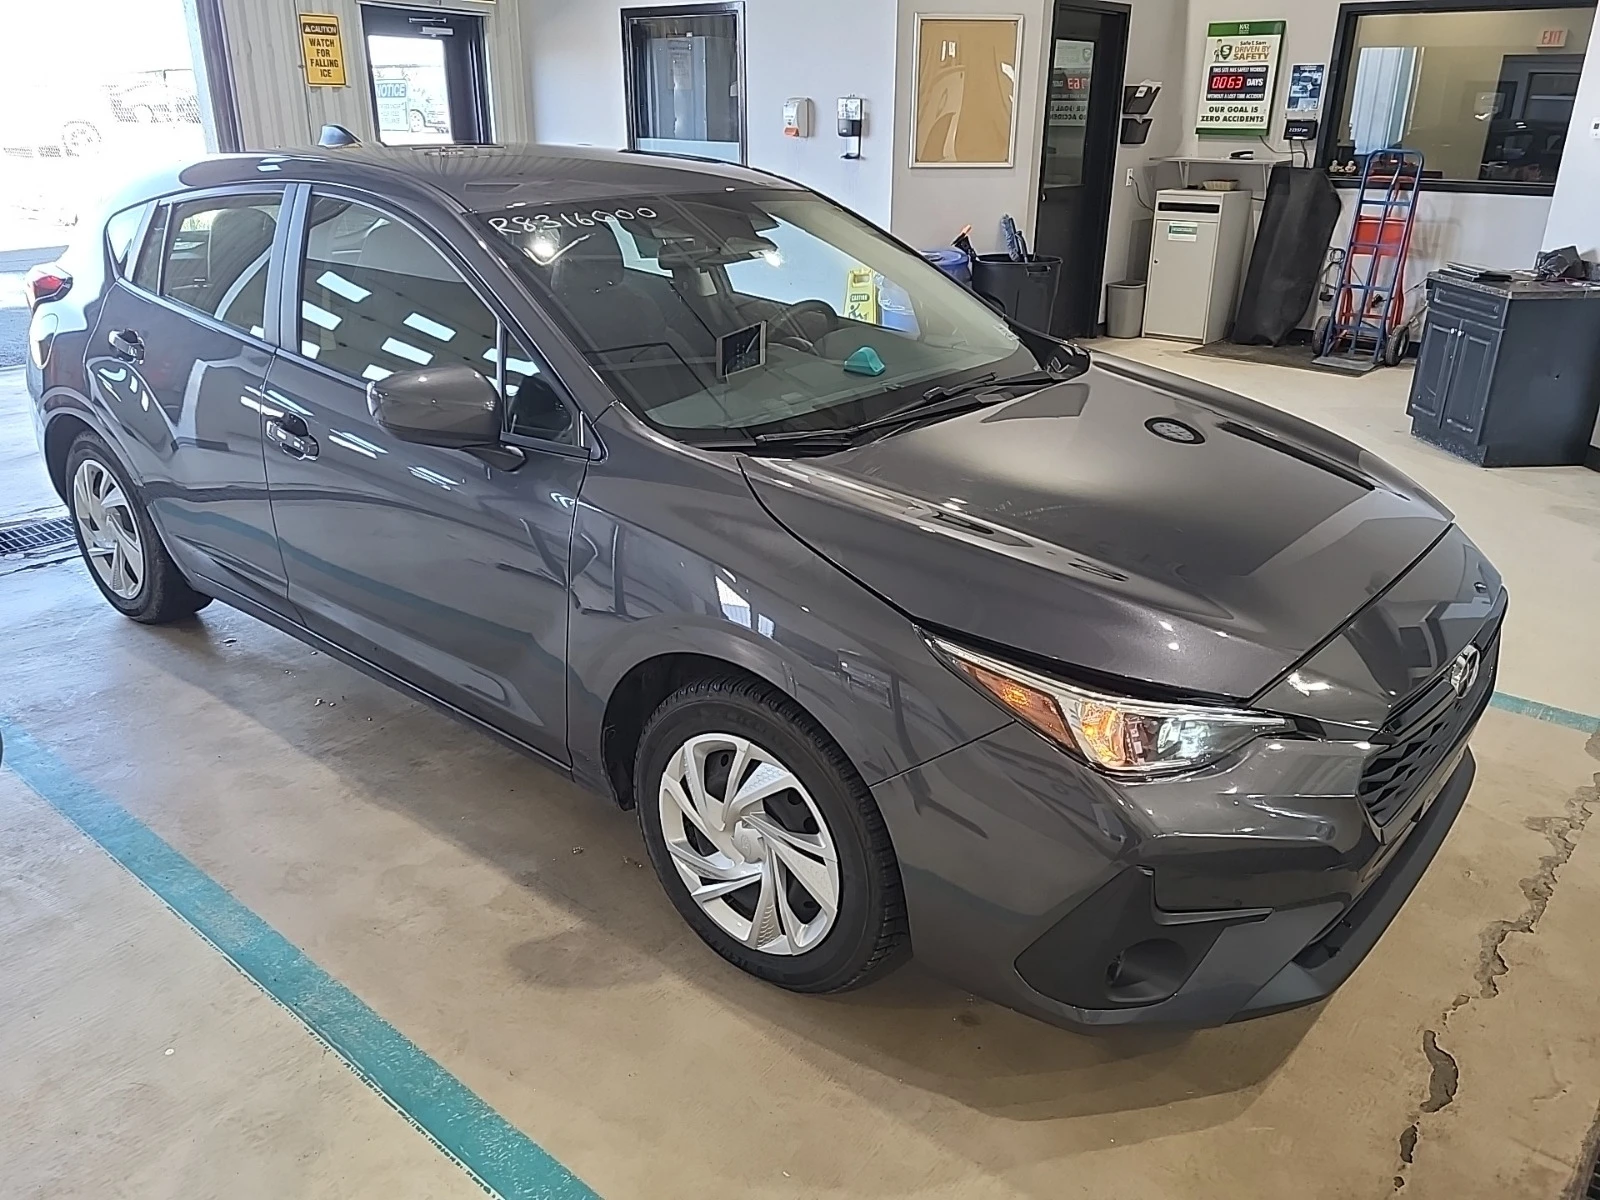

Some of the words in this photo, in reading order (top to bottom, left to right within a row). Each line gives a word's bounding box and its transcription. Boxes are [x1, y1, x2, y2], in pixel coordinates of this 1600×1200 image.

[310, 25, 337, 34] CAUTION
[309, 37, 335, 47] WATCH
[1541, 30, 1564, 44] EXIT
[316, 48, 331, 58] FOR
[1234, 45, 1260, 53] DRIVEN
[1261, 45, 1271, 53] BY
[1233, 52, 1270, 60] SAFETY
[310, 58, 339, 68] FALLING
[319, 68, 332, 78] ICE
[1211, 76, 1244, 89] 0063
[1246, 78, 1264, 87] DAYS
[487, 207, 657, 236] R8316000
